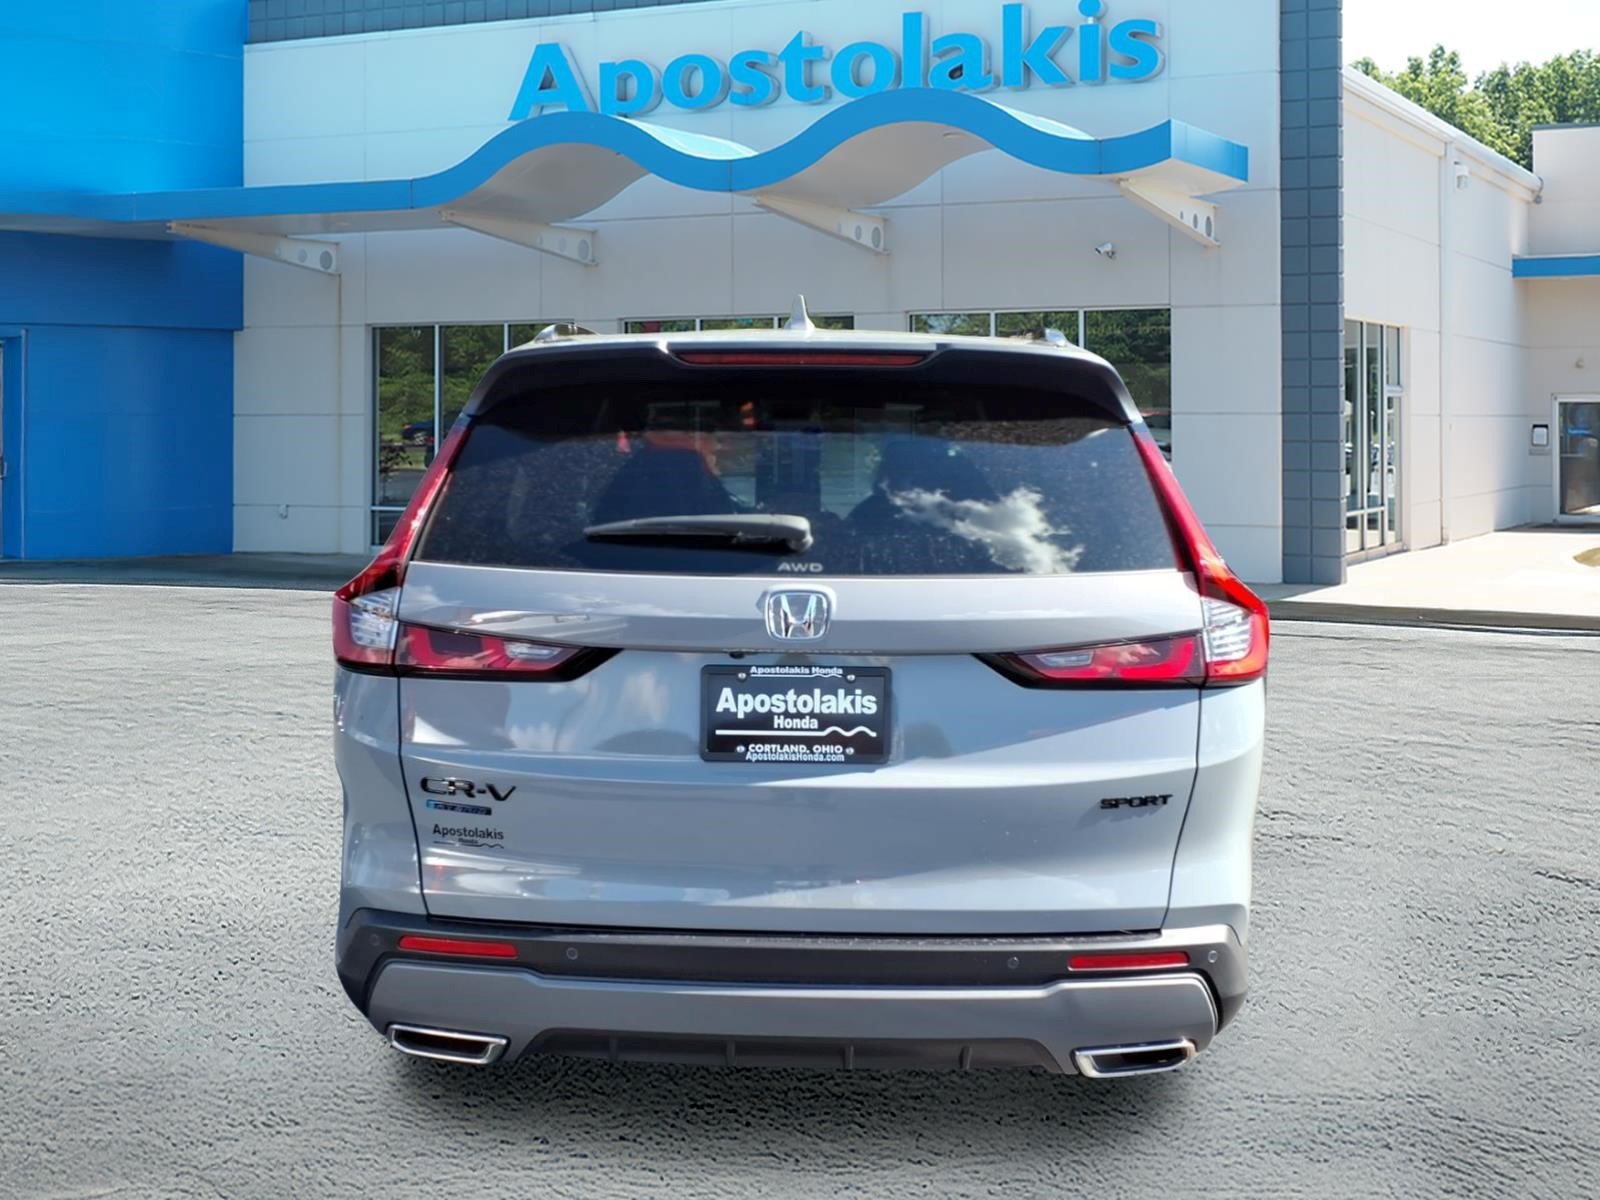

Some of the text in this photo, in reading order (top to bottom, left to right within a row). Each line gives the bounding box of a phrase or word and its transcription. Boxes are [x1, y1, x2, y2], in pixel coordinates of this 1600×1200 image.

[509, 0, 1163, 120] Apostolakis
[777, 562, 823, 572] AWD
[750, 666, 809, 674] Apostolakis
[716, 687, 878, 718] Apostolakis
[774, 715, 818, 729] Honda
[746, 751, 845, 762] ApostolakisHonda.com
[813, 746, 843, 754] OHIO
[421, 777, 516, 801] CR-V
[1100, 794, 1173, 809] SPORT
[433, 824, 504, 840] Apostolakis
